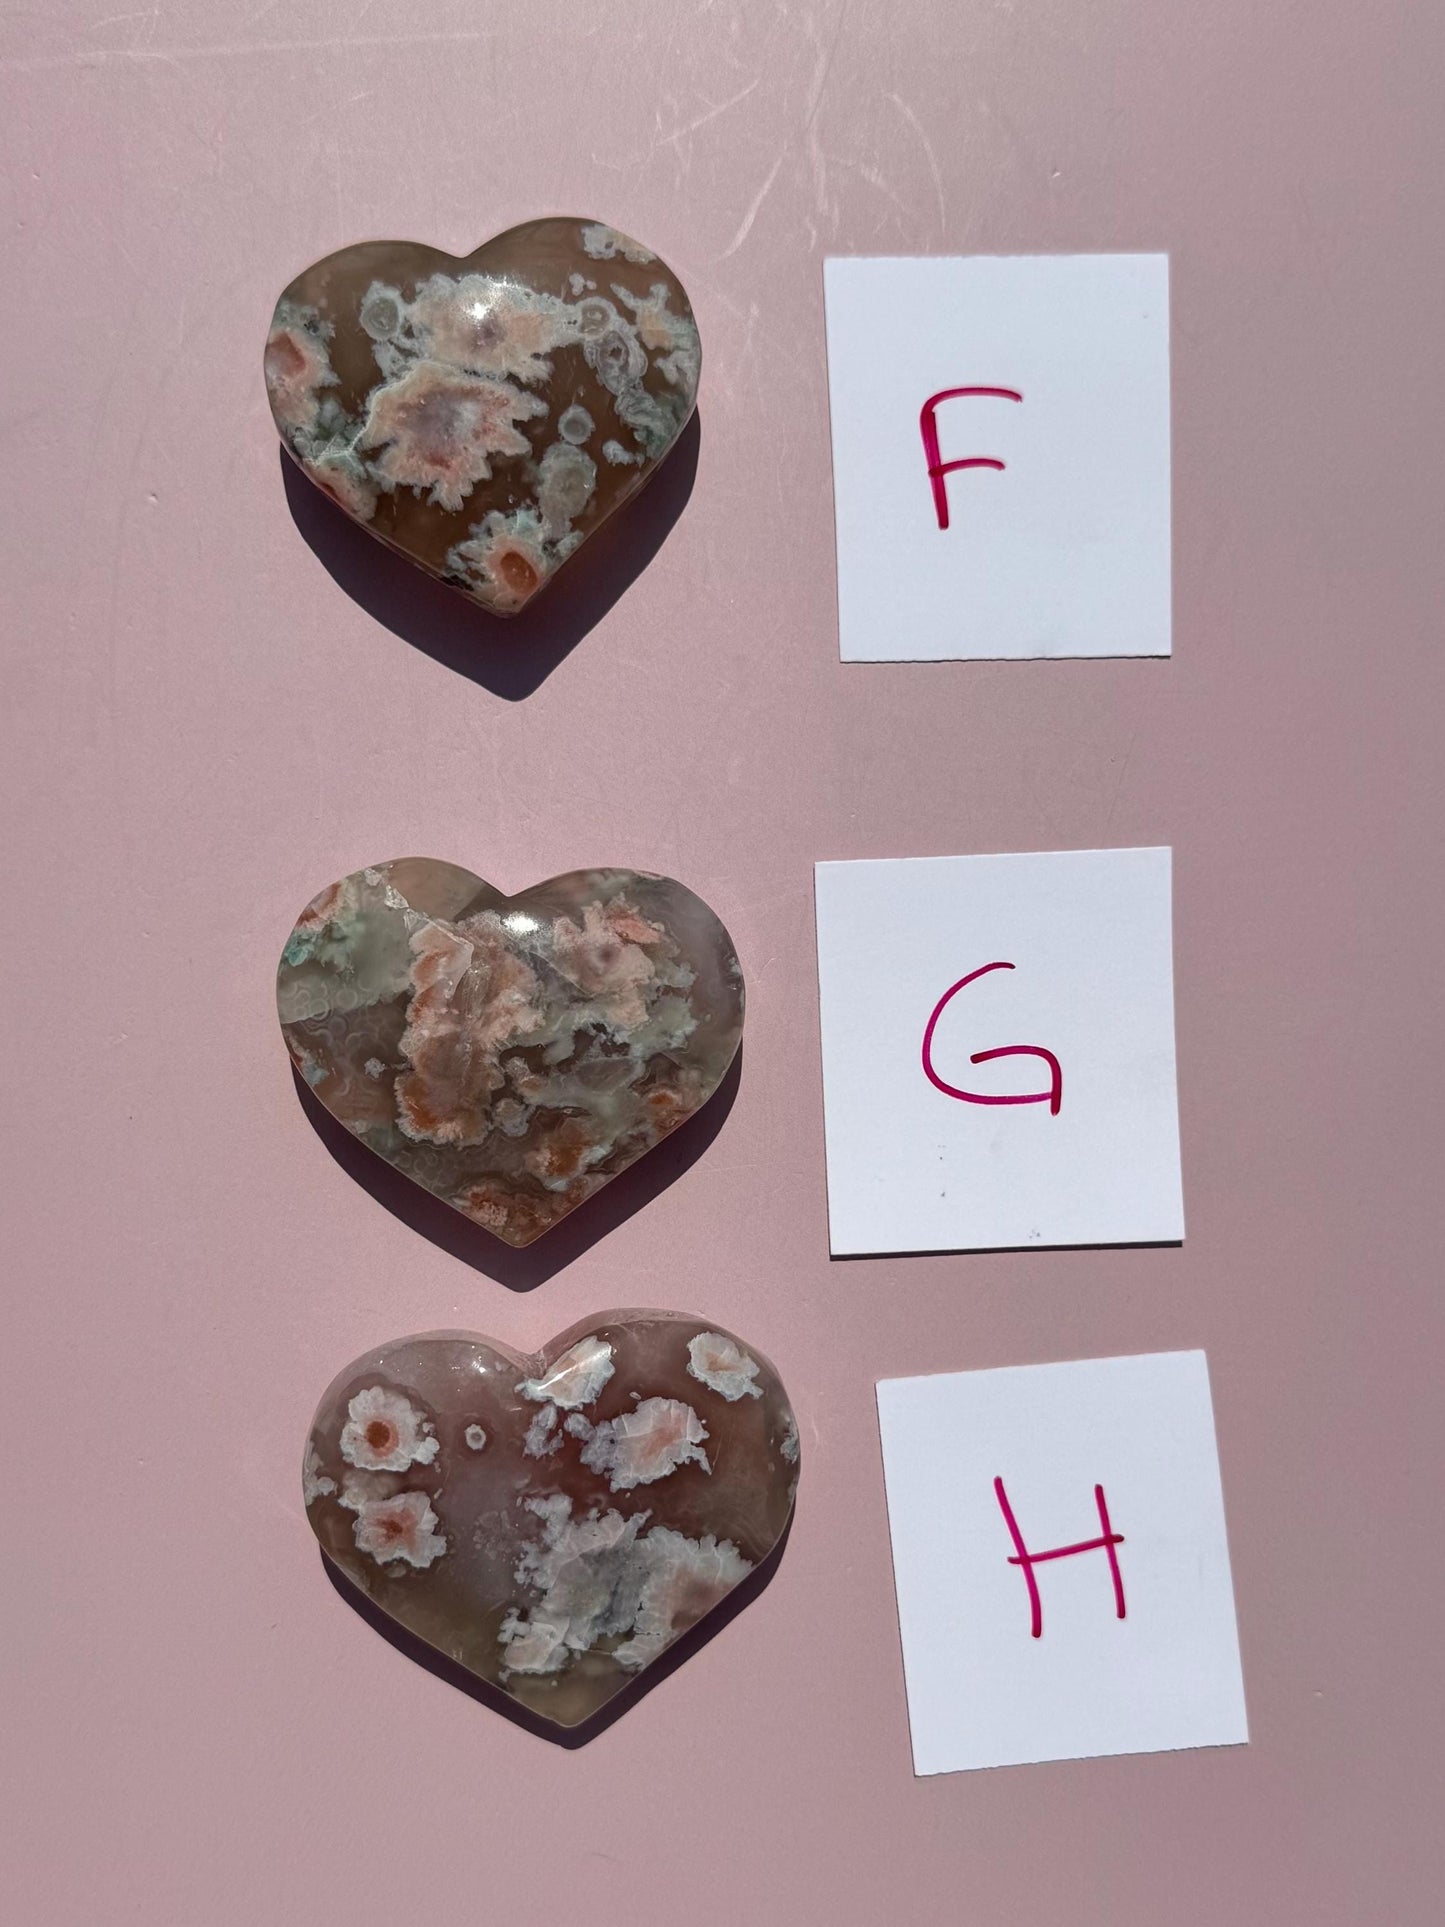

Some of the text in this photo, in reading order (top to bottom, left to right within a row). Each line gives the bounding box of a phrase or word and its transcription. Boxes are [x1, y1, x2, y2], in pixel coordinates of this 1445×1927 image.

[920, 386, 1023, 530] F
[922, 962, 1063, 1116] G
[994, 1476, 1126, 1639] H
